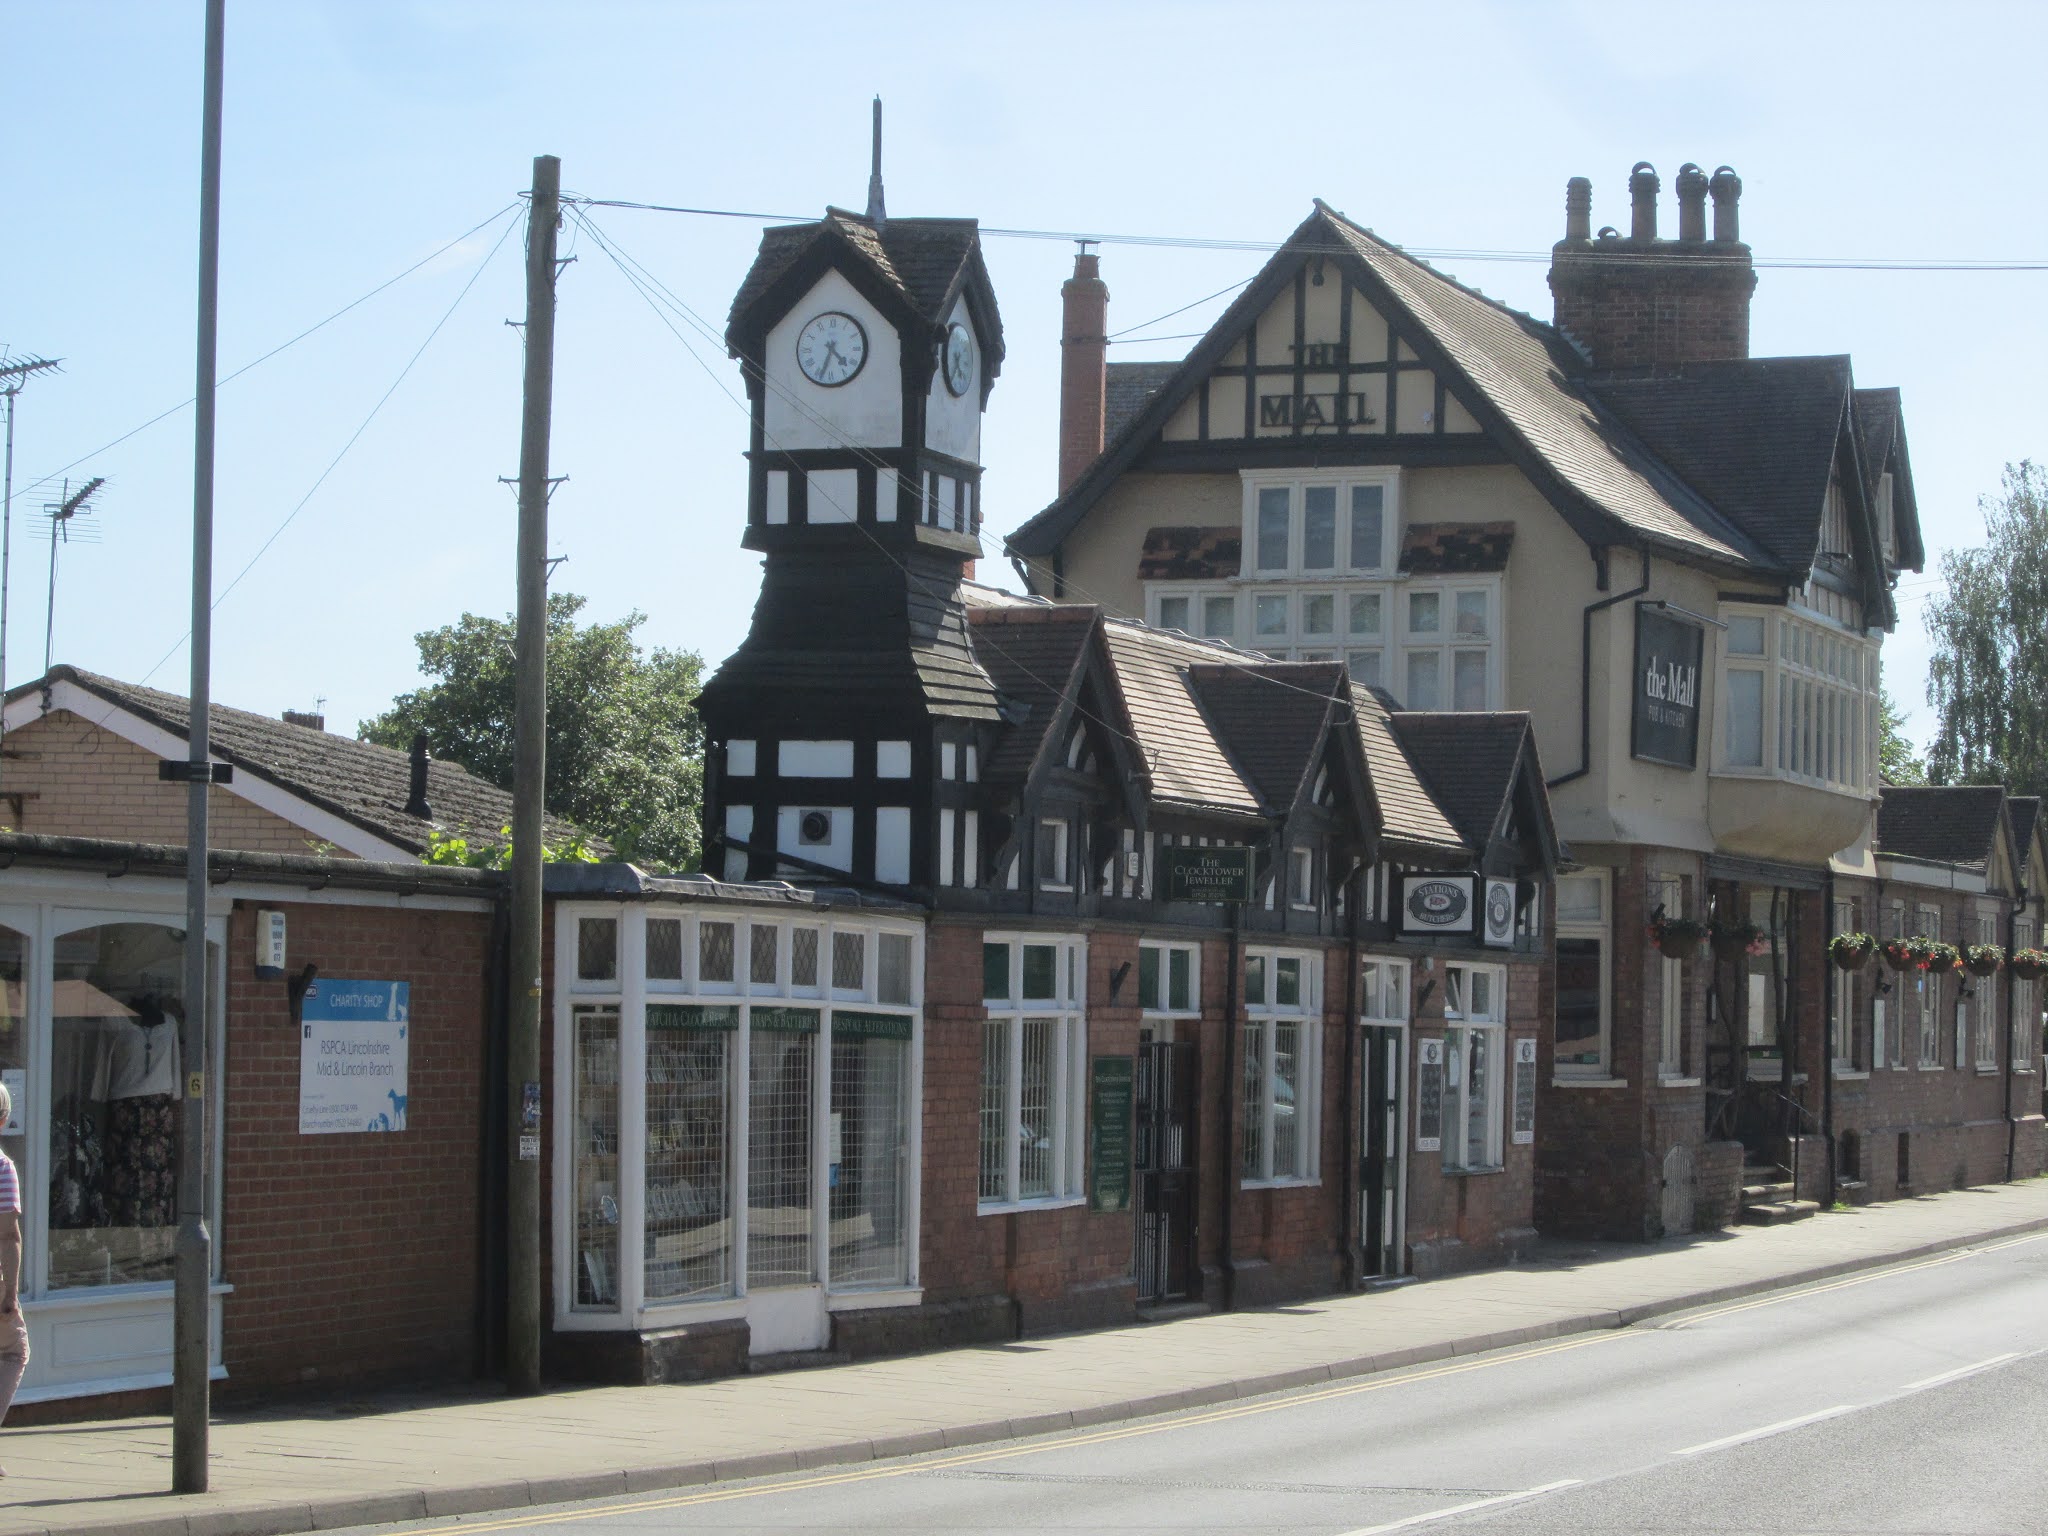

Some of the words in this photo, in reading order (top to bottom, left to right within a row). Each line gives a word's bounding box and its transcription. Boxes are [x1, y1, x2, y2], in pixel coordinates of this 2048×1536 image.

[1288, 343, 1349, 366] THE
[1260, 392, 1376, 427] MALL
[1647, 656, 1666, 700] the
[1667, 662, 1695, 708] Mall
[1200, 857, 1220, 867] THE
[1175, 865, 1245, 876] CLOCKTOWER
[1185, 875, 1234, 887] JEWELLER
[1418, 884, 1459, 898] STATIONS
[1420, 912, 1455, 923] BUTCHERS
[330, 994, 362, 1008] CHARITY
[363, 994, 384, 1008] SHOP
[647, 1010, 671, 1027] ATCH
[750, 1013, 773, 1028] TRAPS
[320, 1040, 346, 1055] RSPCA
[348, 1040, 390, 1055] Lincolnshire
[317, 1061, 332, 1076] Mid
[334, 1062, 340, 1076] &
[342, 1061, 367, 1076] Lincoln
[369, 1060, 394, 1076] Branch
[191, 1078, 200, 1092] 6
